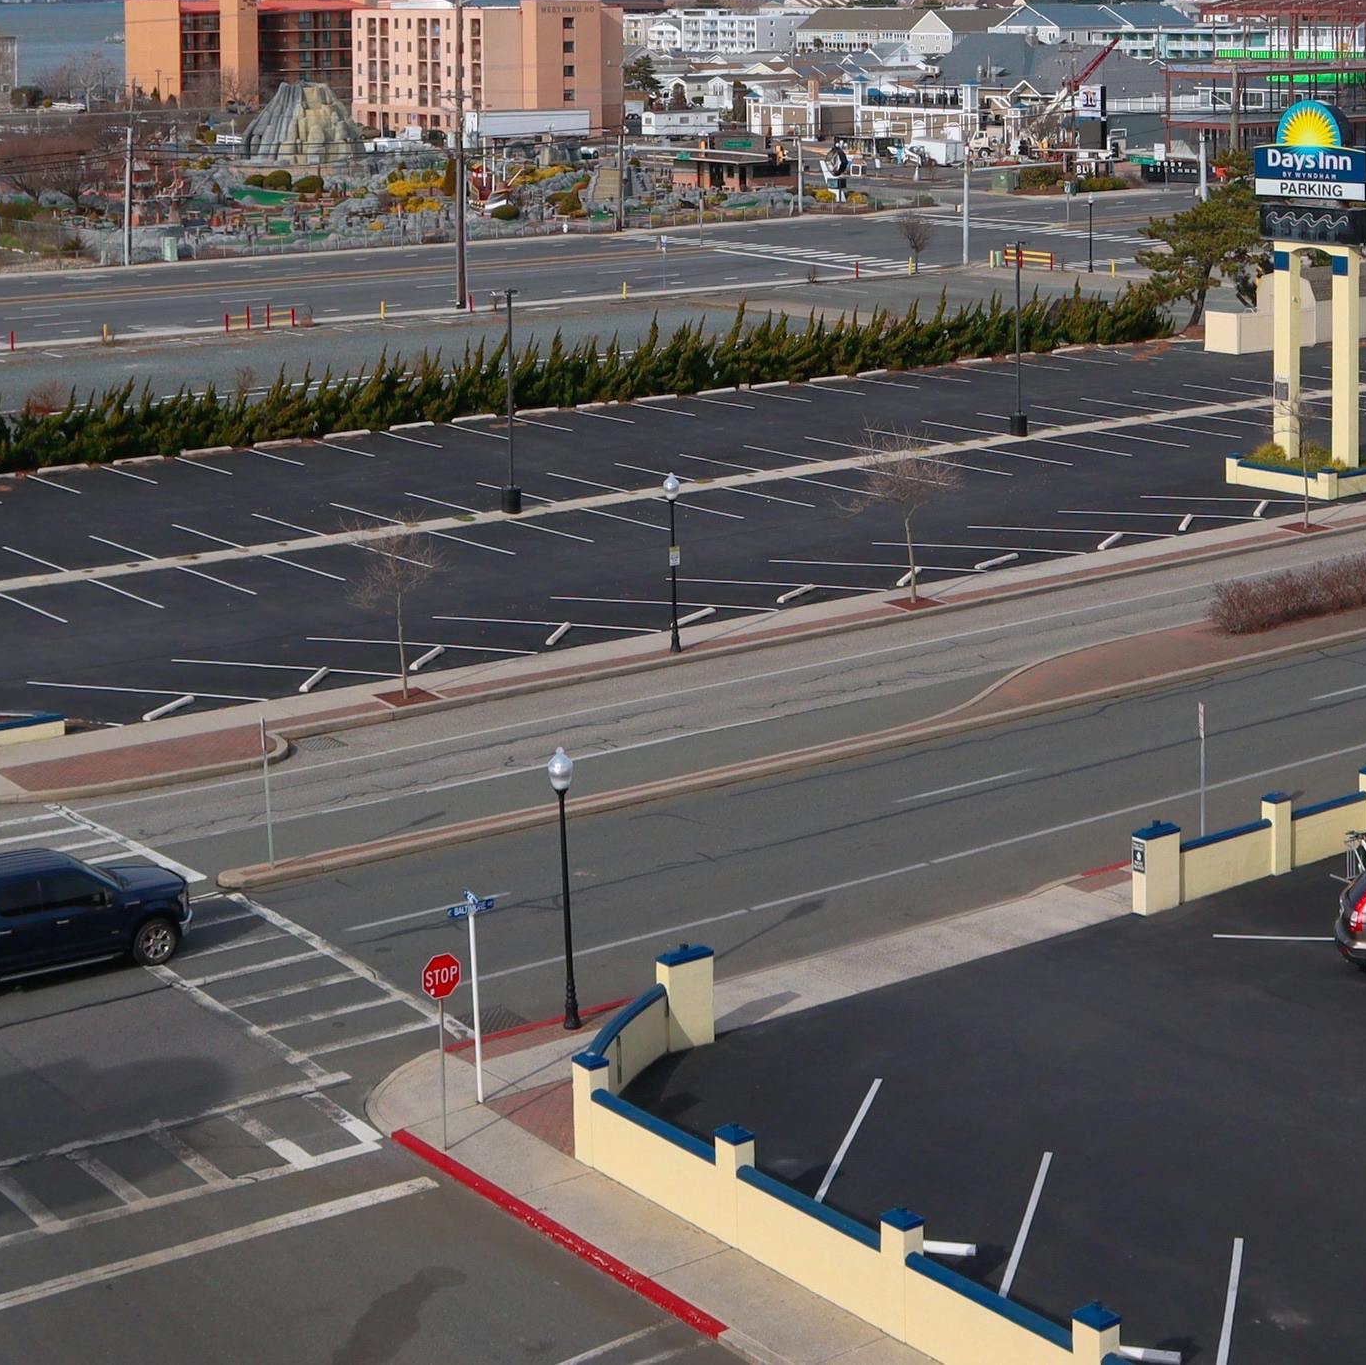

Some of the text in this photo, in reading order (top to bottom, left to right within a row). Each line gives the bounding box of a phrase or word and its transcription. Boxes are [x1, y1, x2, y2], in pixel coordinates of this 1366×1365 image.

[1267, 148, 1352, 171] Days Inn
[1295, 172, 1337, 180] WYNDHAM
[1280, 182, 1343, 197] PARKING
[425, 965, 458, 987] STOP
